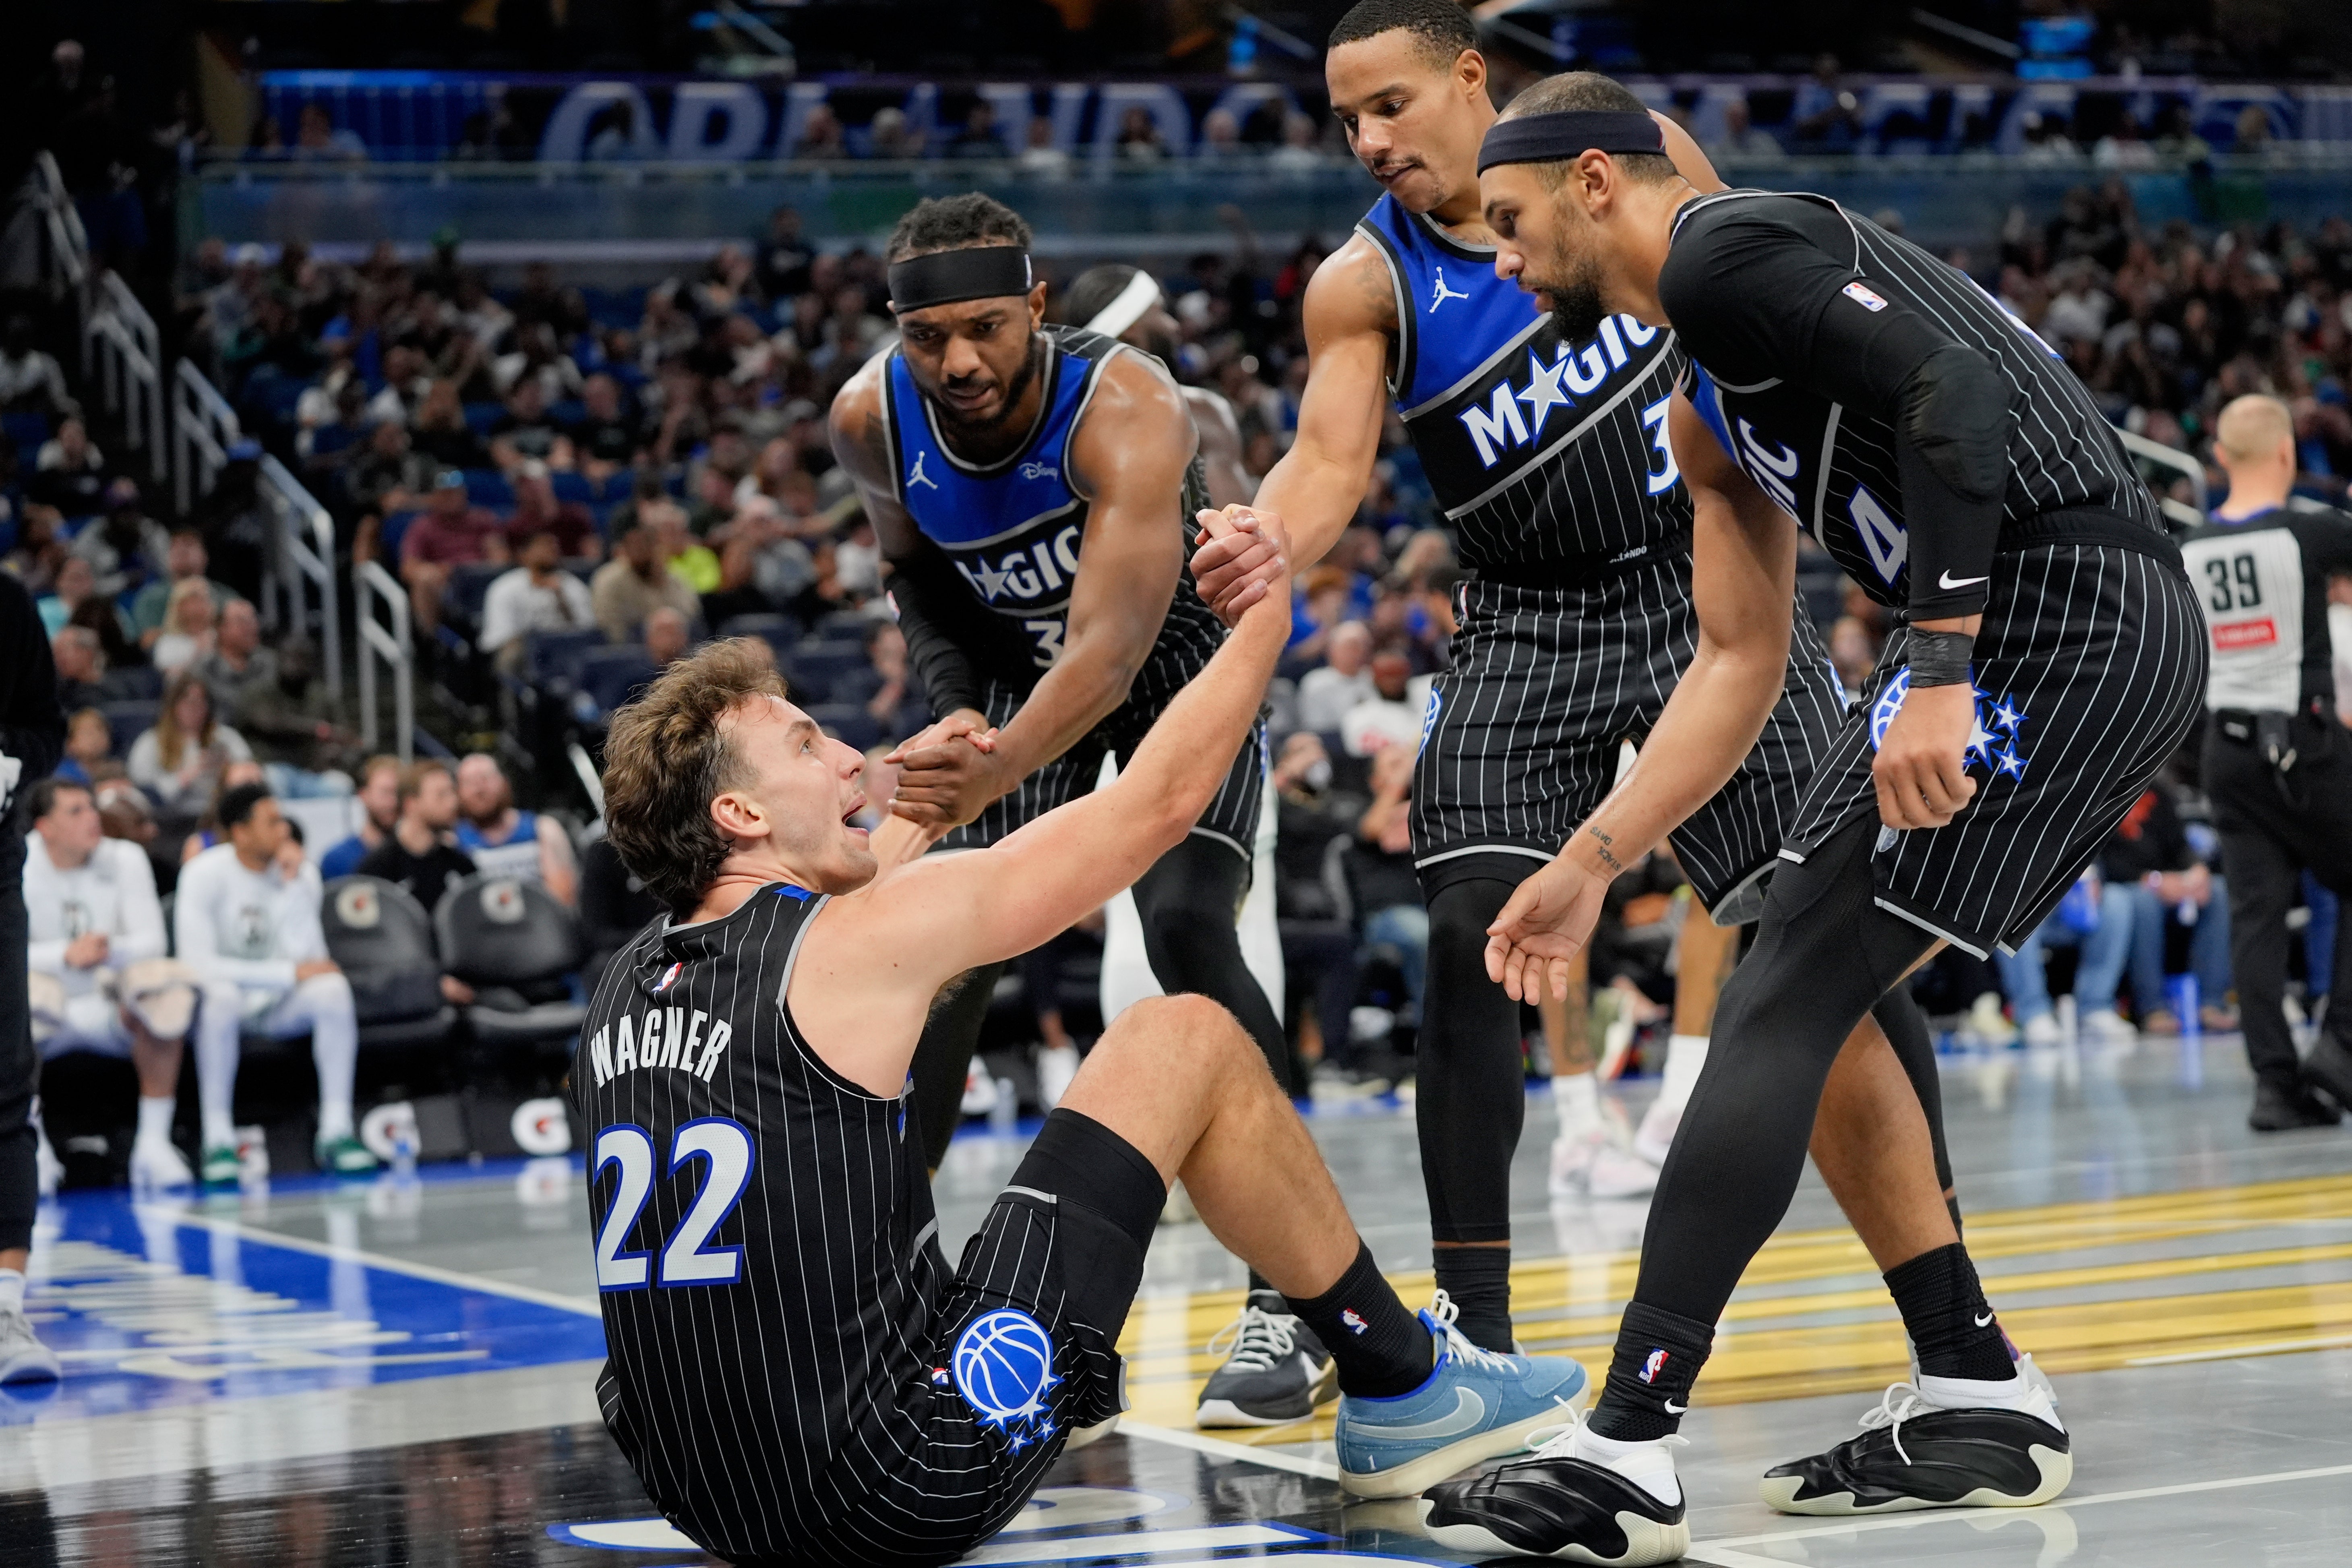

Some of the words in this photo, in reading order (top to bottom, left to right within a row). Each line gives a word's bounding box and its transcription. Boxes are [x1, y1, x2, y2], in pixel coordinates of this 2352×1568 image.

[1642, 393, 1682, 496] 3
[1845, 482, 1908, 590] 4
[2205, 552, 2262, 612] 39
[1589, 826, 1612, 846] DAYS
[1597, 846, 1621, 871] STACK
[590, 1006, 732, 1089] WAGNER
[594, 1116, 755, 1292] 22
[1638, 1370, 1650, 1382] NBA
